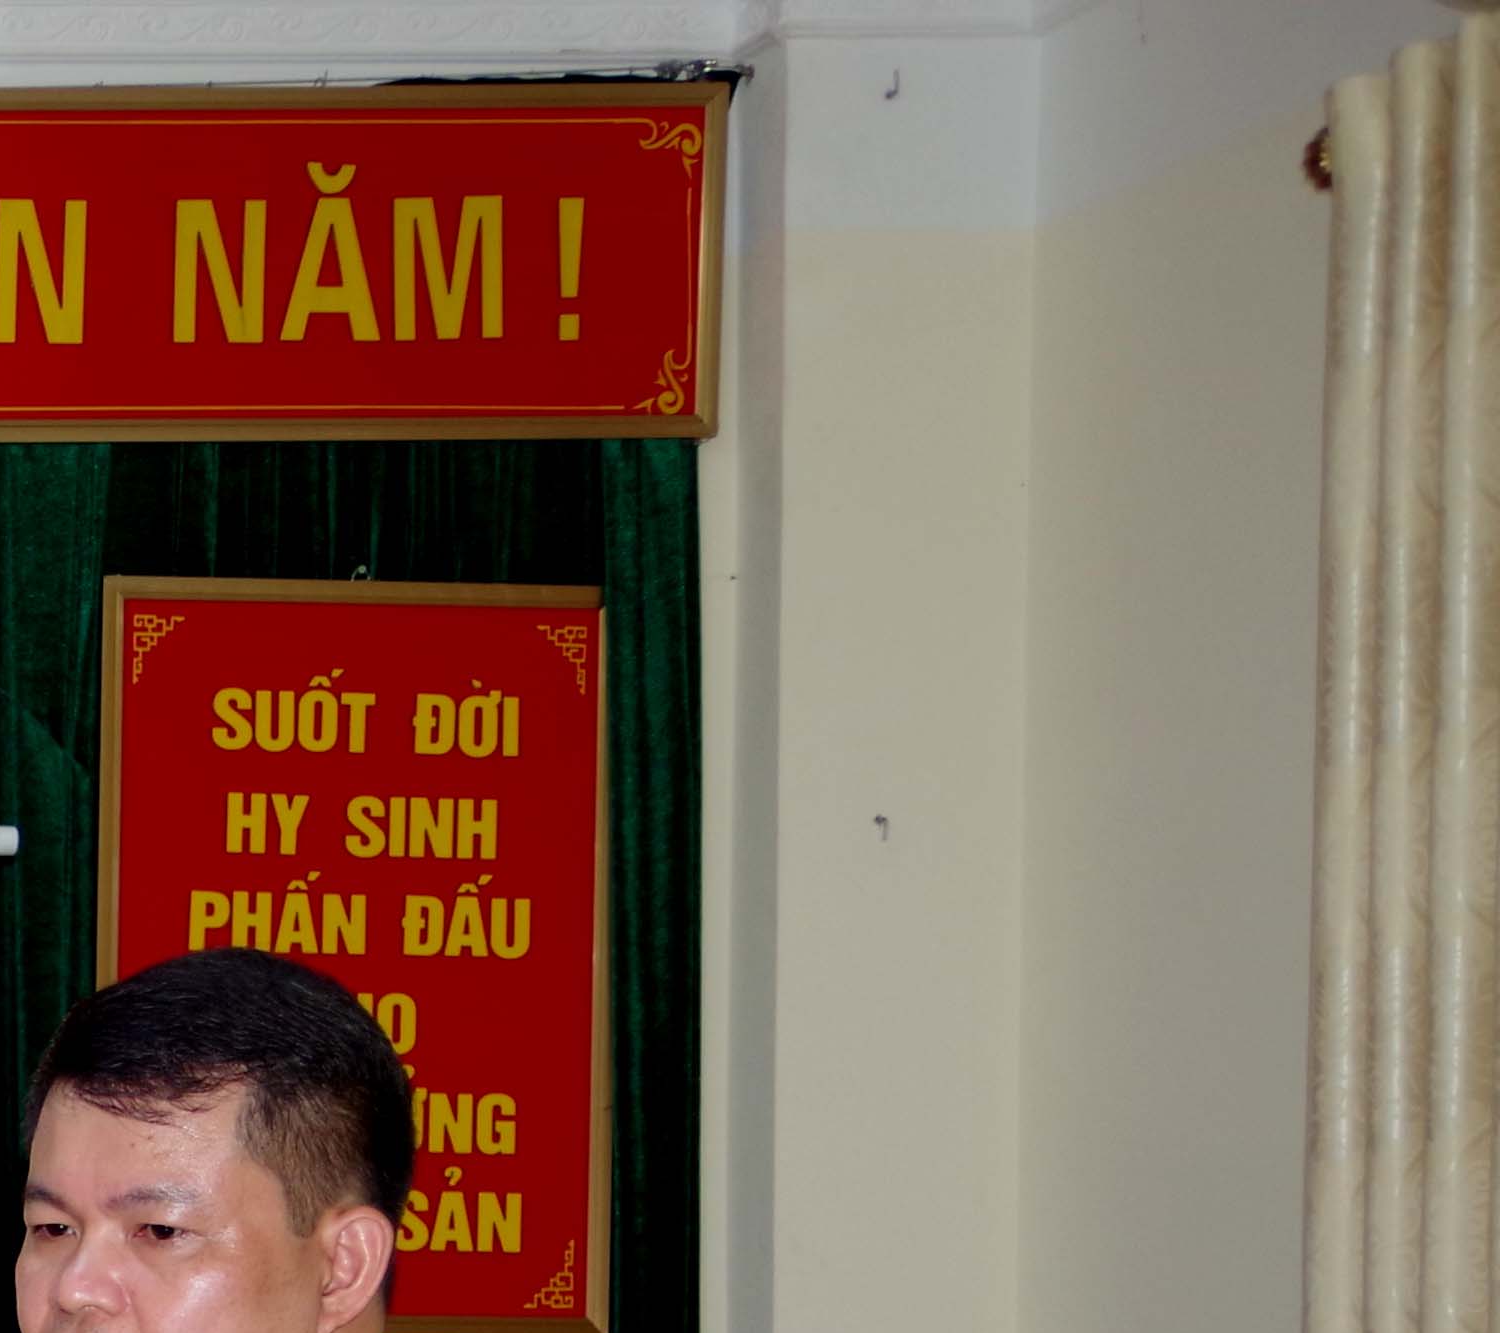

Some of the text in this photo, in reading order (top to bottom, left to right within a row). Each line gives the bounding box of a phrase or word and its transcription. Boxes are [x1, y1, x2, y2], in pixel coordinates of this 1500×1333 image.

[174, 163, 502, 343] NĂM
[211, 668, 520, 758] SUỐT ĐỜI
[226, 792, 498, 860] HY SINH
[188, 871, 531, 959] PHẤN ĐẤU
[396, 1166, 522, 1254] SẢN
